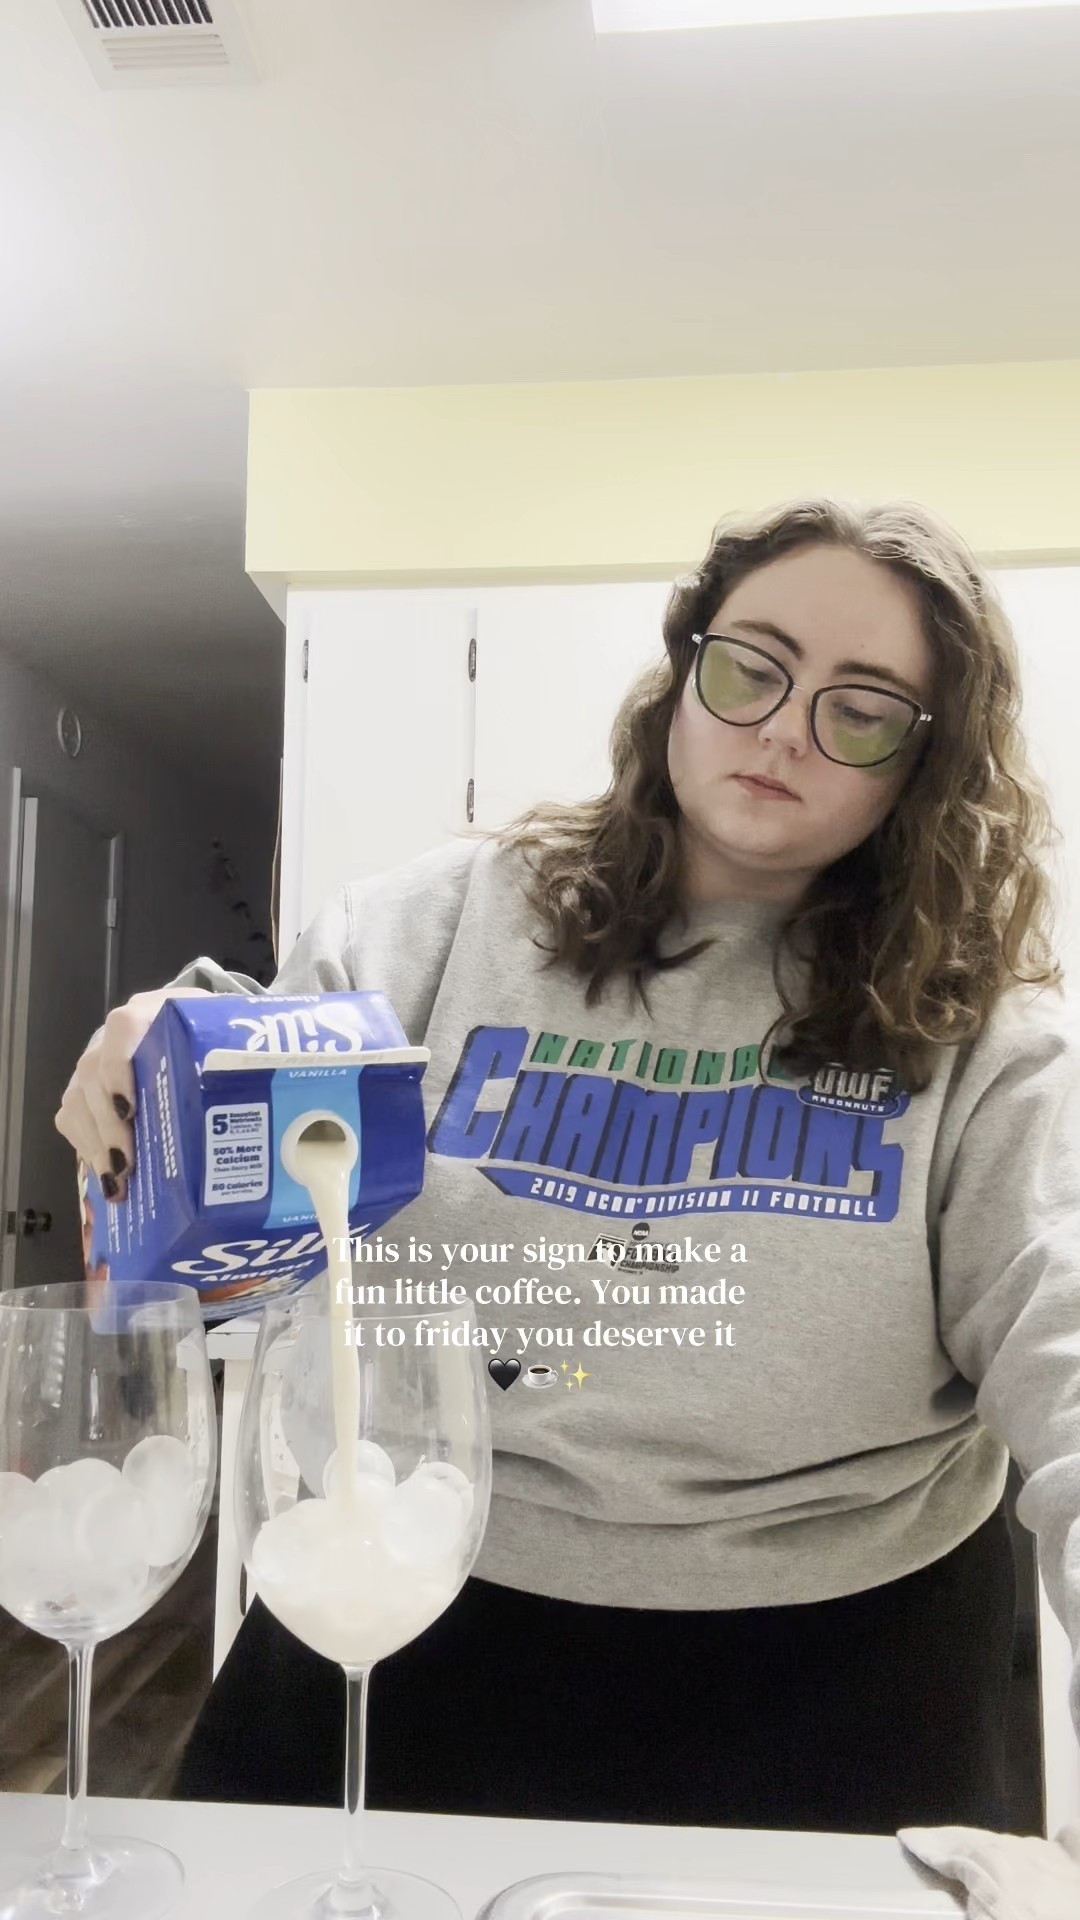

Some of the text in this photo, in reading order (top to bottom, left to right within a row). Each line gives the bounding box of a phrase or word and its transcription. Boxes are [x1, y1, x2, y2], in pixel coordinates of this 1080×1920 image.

[228, 1003, 362, 1053] Silk
[289, 1069, 348, 1079] VANILLA
[814, 1067, 894, 1102] UWF
[426, 1025, 906, 1197] CHAMPIONS
[811, 1095, 885, 1112] ARGONAUTS
[212, 1113, 228, 1135] 5
[213, 1145, 263, 1156] 50% More
[216, 1154, 260, 1165] Calcium
[227, 1180, 263, 1190] Calories
[530, 1177, 577, 1203] 2019
[646, 1190, 731, 1213] DIVISION
[742, 1190, 759, 1206] II
[770, 1191, 877, 1217] FOOTBALL
[201, 1259, 314, 1282] Almond
